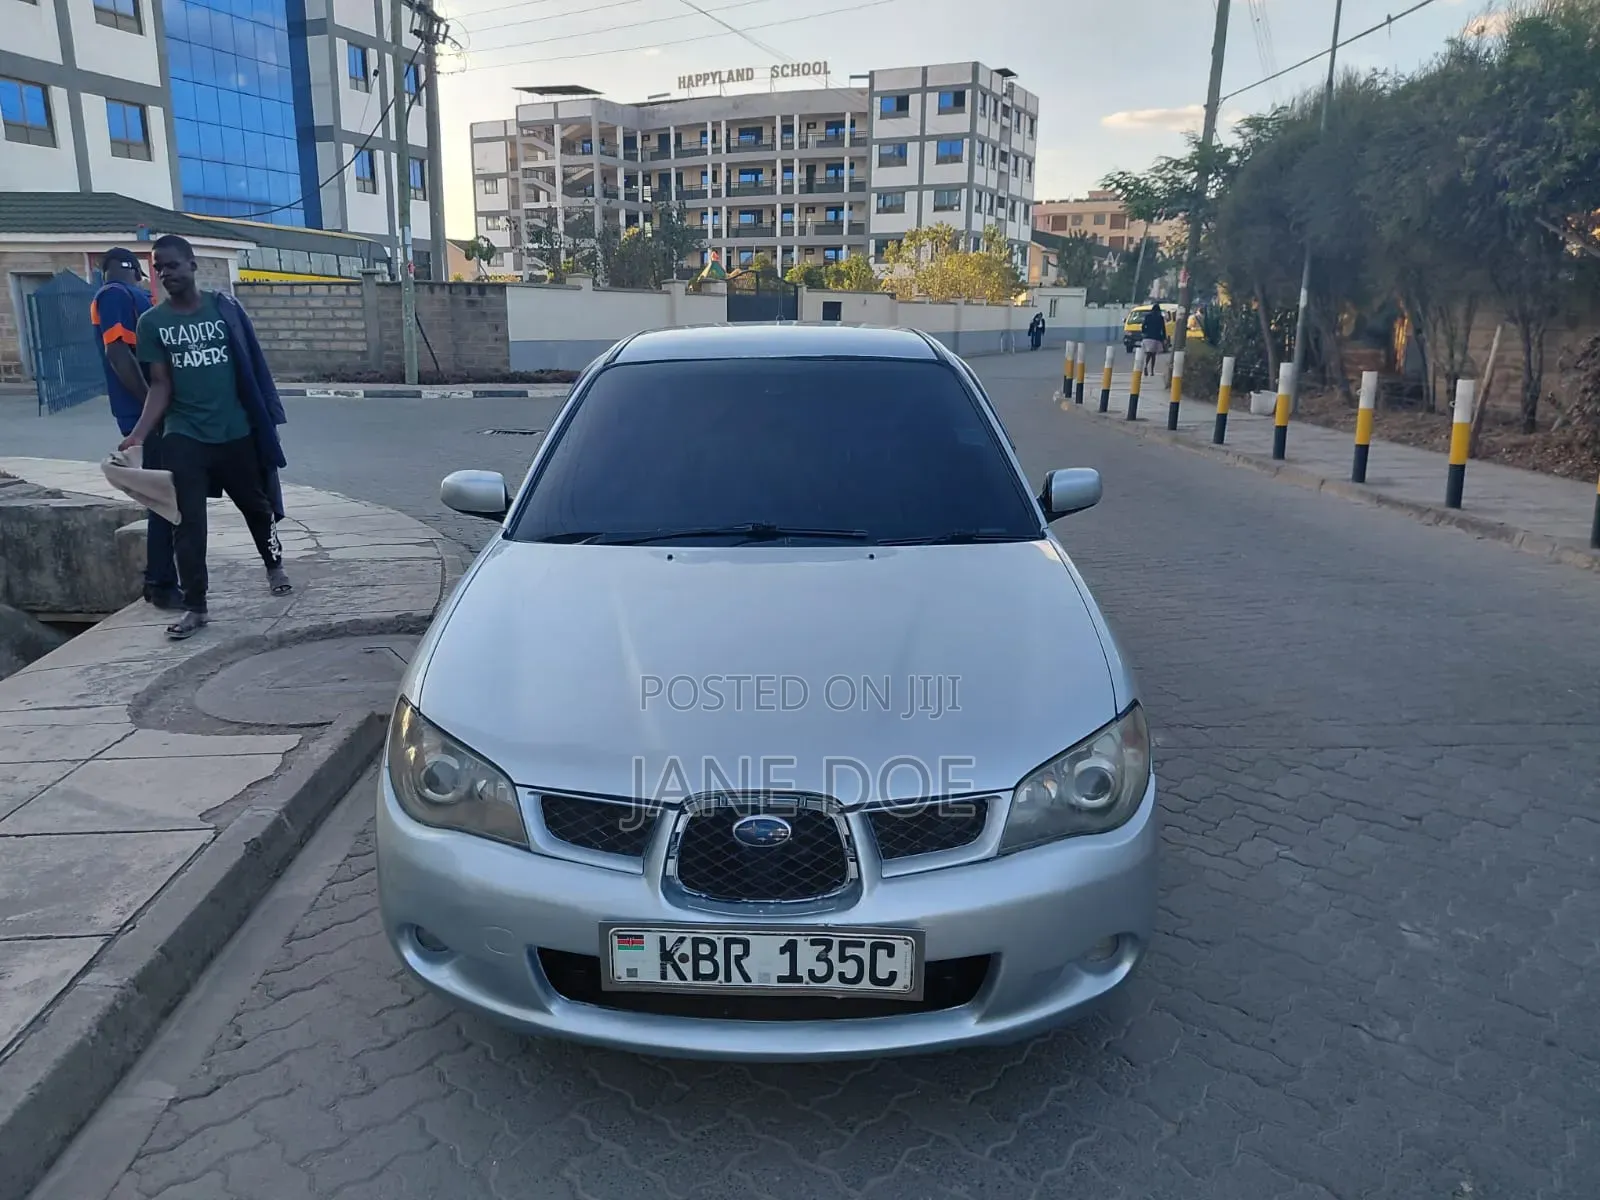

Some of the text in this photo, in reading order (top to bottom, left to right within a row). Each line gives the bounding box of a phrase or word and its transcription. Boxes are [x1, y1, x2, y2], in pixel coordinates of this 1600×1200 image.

[678, 61, 831, 89] HAPPYLAND SCHOOL
[159, 319, 225, 347] READERS
[659, 935, 752, 984] KBR
[777, 938, 898, 987] 135C
